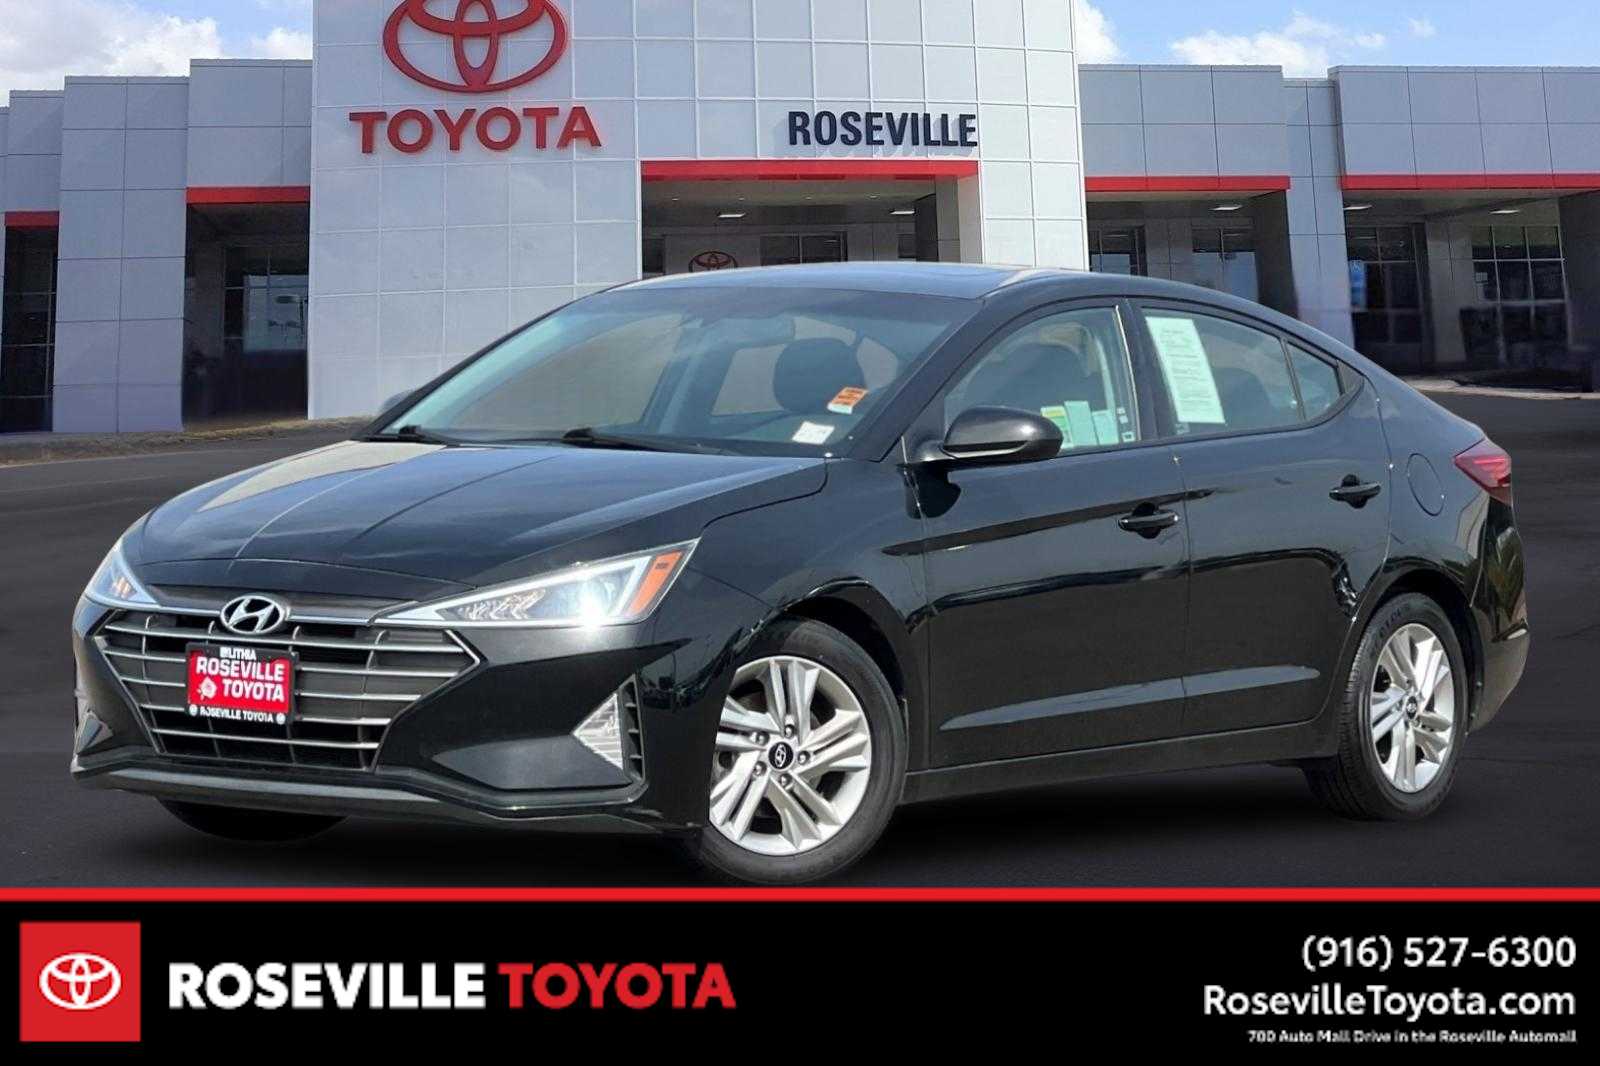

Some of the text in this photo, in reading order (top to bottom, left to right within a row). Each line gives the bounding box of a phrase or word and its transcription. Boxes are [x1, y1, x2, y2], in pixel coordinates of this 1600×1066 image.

[349, 106, 602, 154] TOYOTA
[788, 111, 979, 147] ROSEVILLE
[196, 656, 285, 681] ROSEVILLE
[222, 679, 284, 703] TOYOTA
[199, 706, 274, 723] ROSEVILLE TOYOTA
